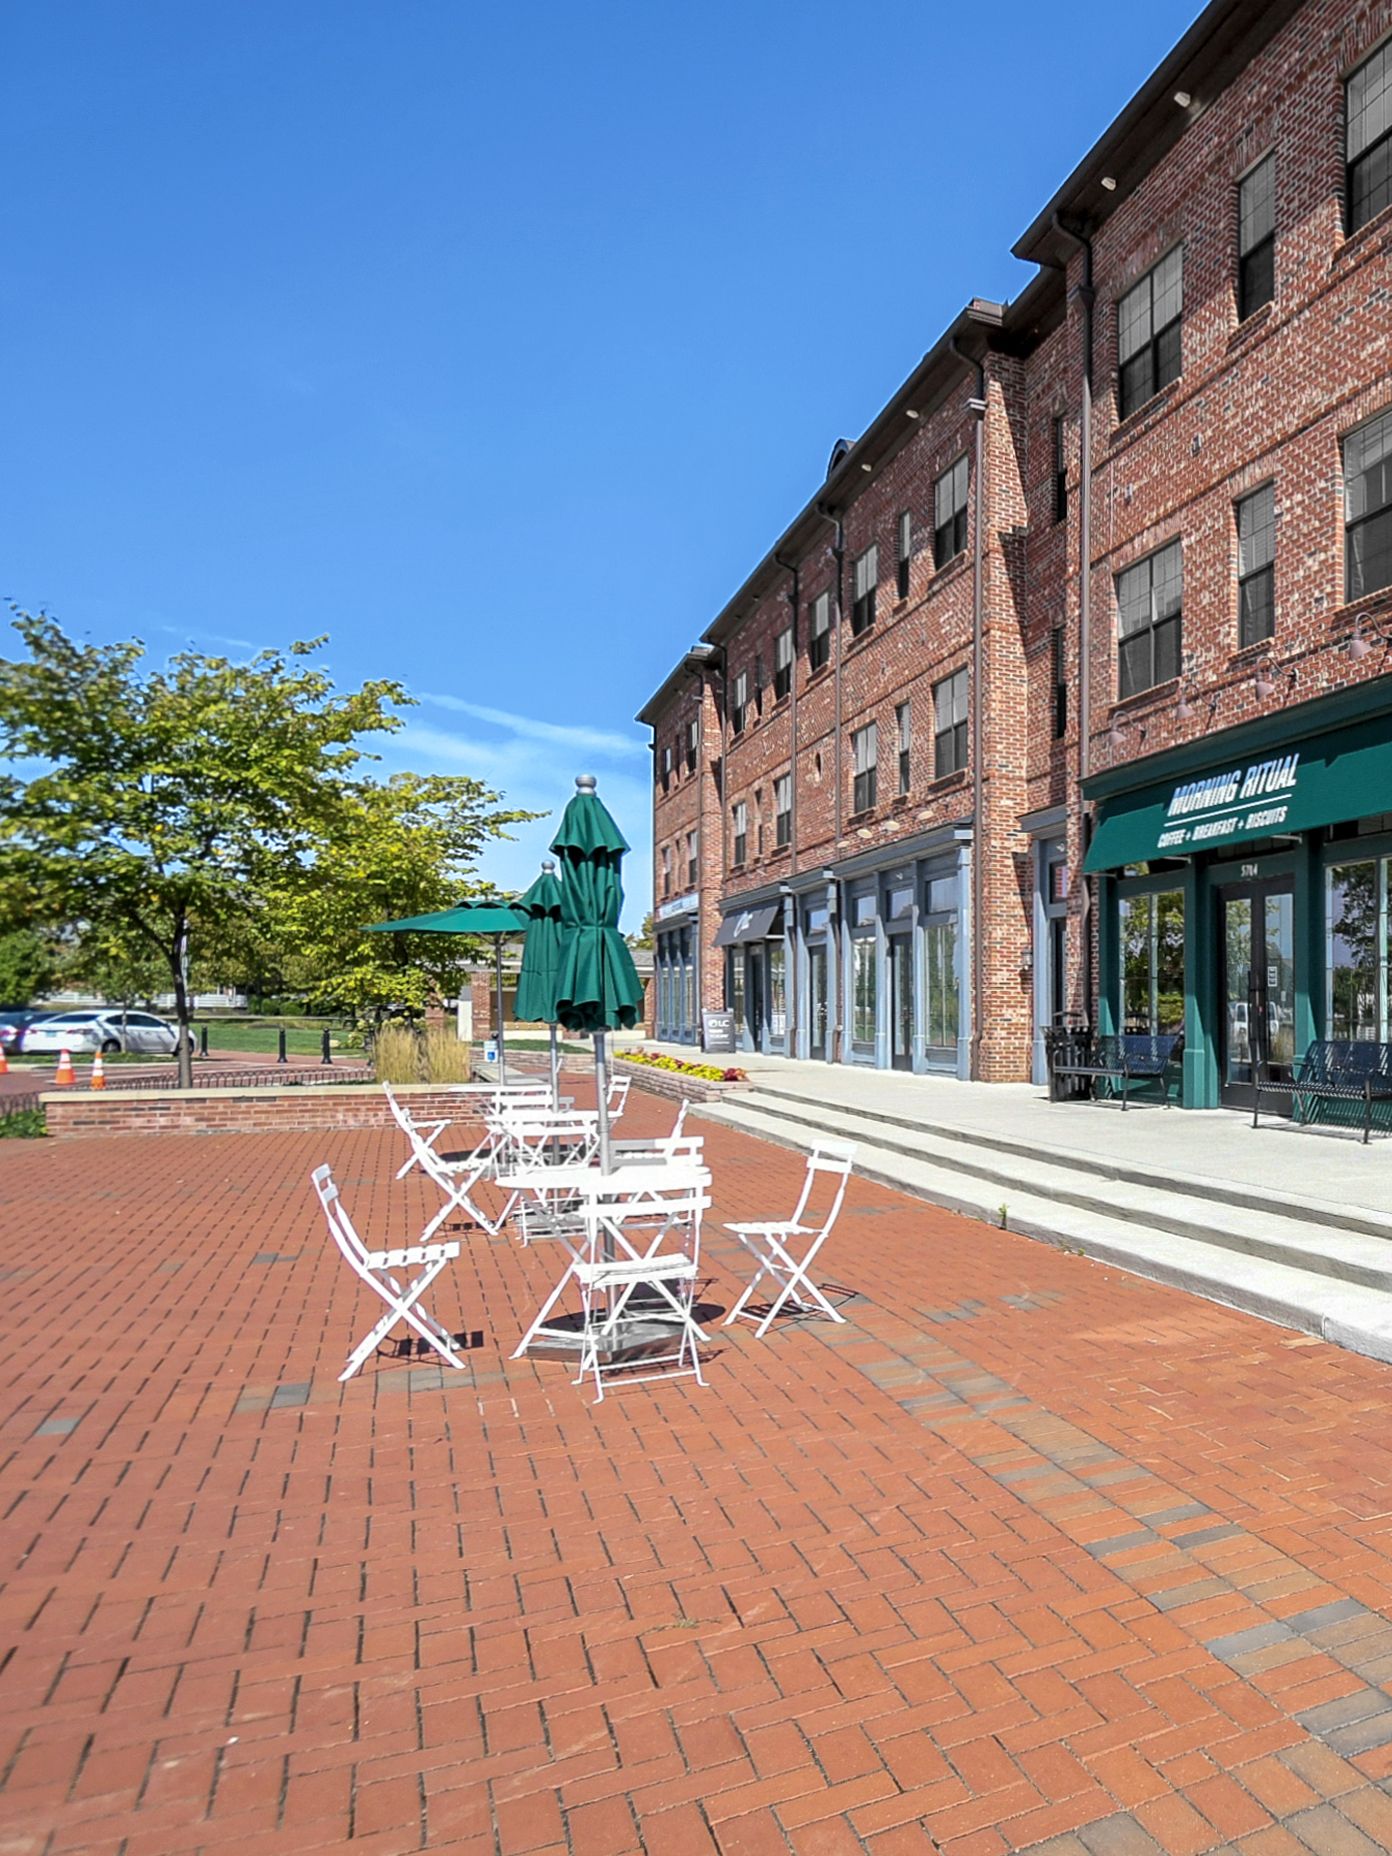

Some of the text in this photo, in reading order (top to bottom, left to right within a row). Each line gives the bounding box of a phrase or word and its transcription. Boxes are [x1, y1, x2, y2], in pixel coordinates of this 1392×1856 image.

[1167, 753, 1300, 816] MORNING RITUAL
[1157, 829, 1186, 848] COFFEE
[1191, 817, 1238, 841] BREAKFAST
[1245, 805, 1288, 830] BISCUITS
